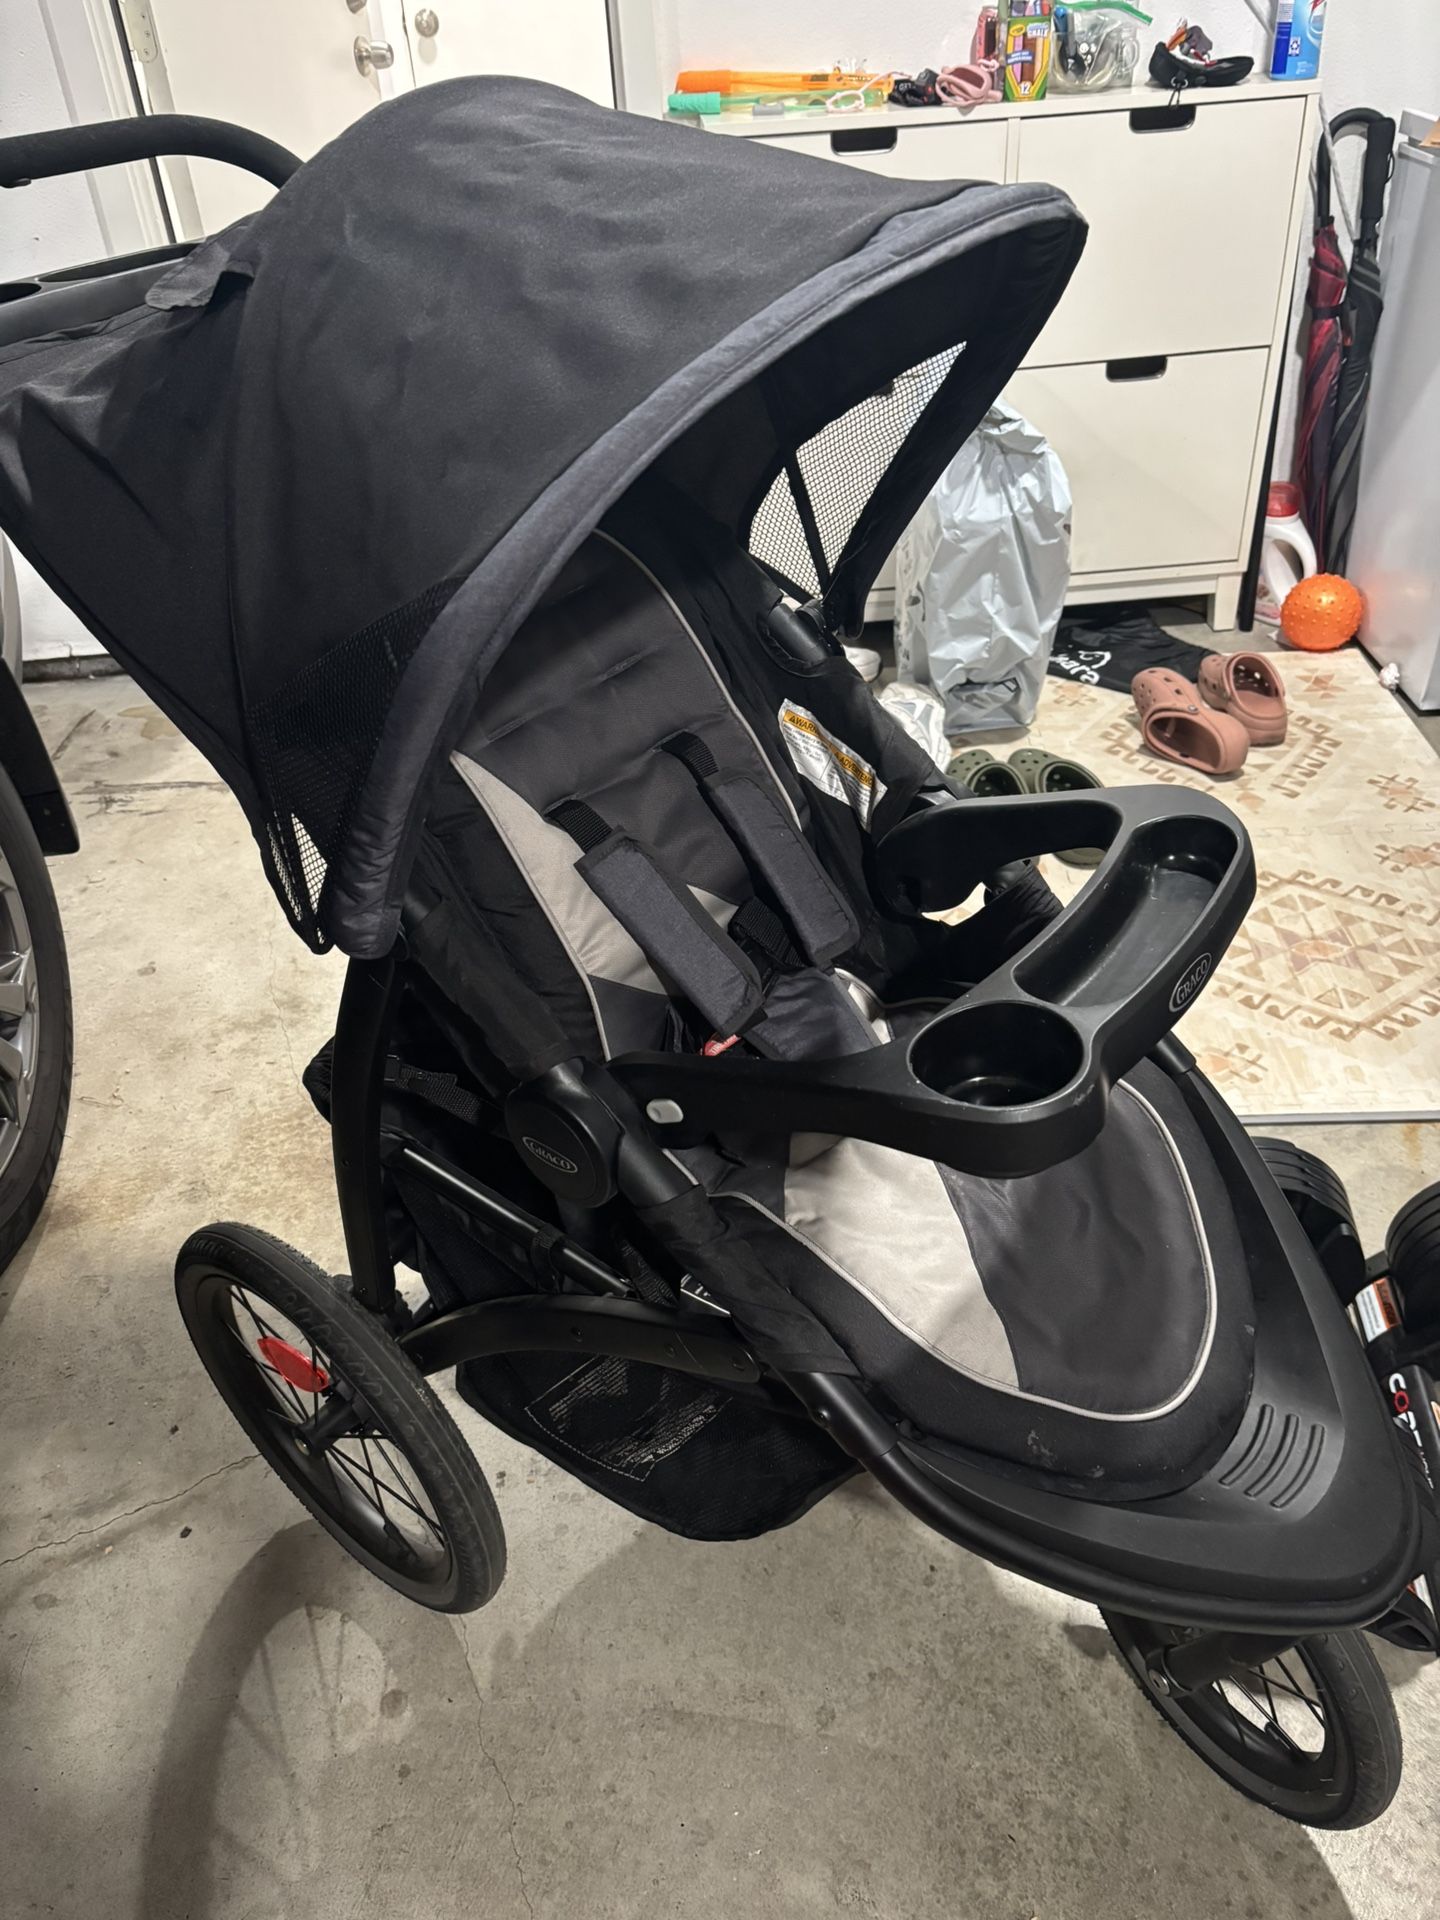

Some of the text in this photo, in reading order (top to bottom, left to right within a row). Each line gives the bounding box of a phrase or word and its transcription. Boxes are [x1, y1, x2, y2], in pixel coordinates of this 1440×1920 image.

[1019, 82, 1031, 95] 12
[1175, 959, 1207, 1005] GRACO
[529, 1141, 570, 1170] GRACO
